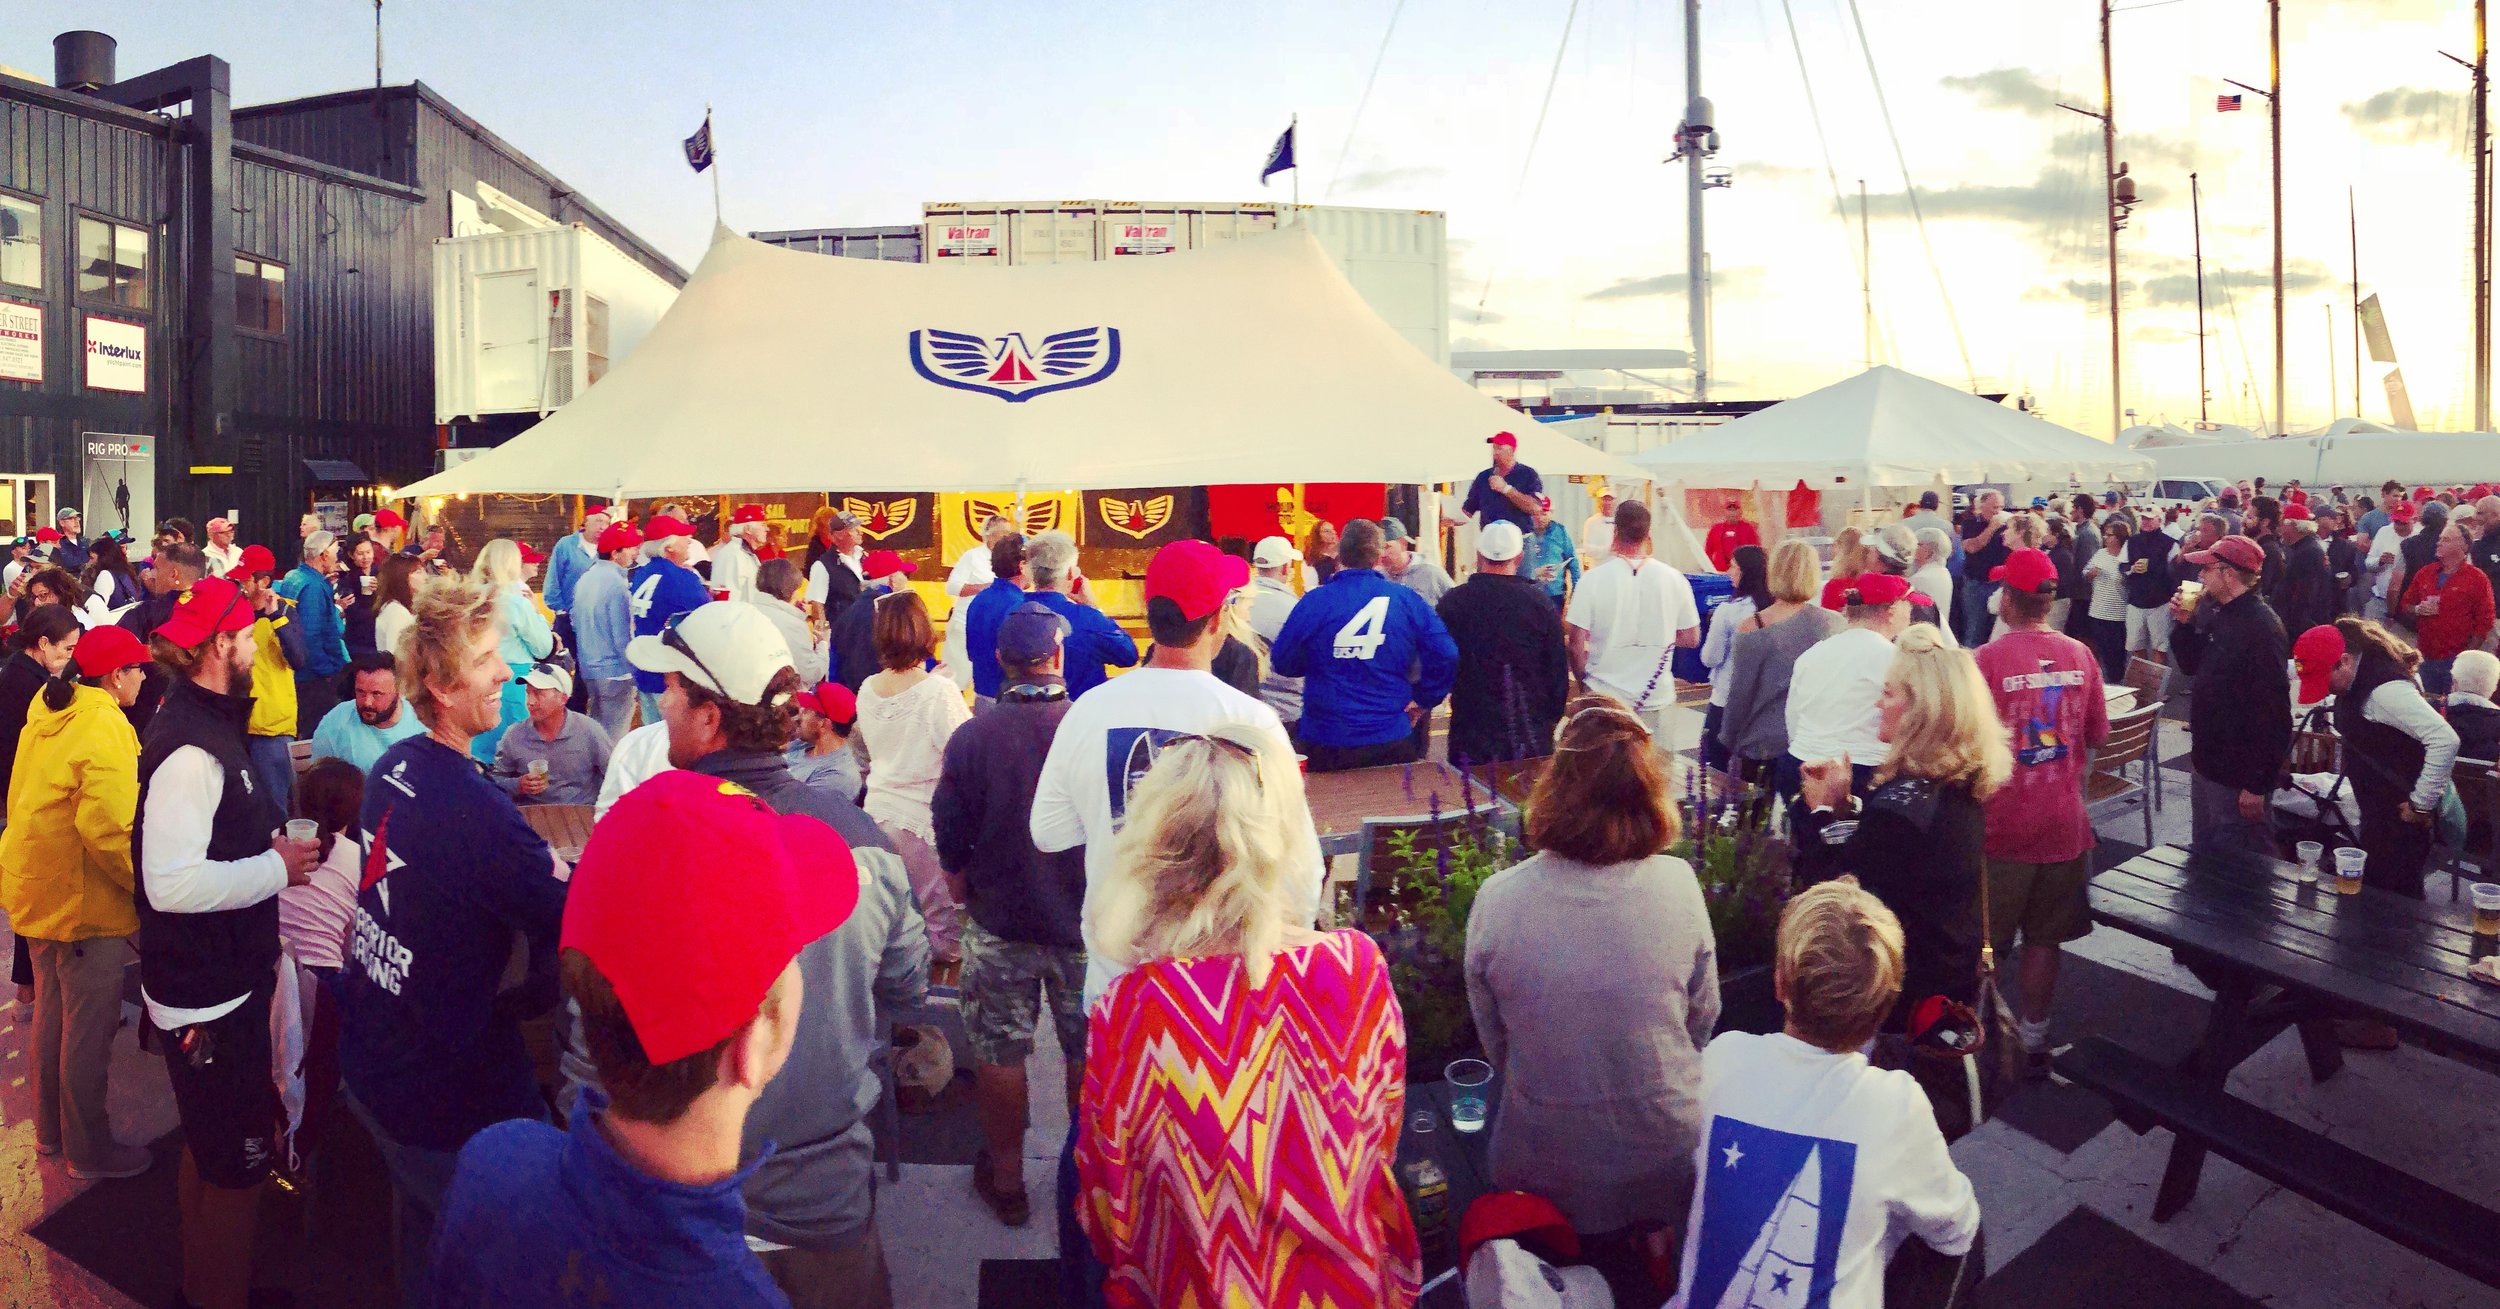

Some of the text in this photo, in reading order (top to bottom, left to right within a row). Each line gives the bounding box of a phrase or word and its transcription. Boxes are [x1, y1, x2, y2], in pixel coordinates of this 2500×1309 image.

[948, 227, 990, 239] Vatran
[1125, 225, 1168, 237] Varan
[10, 315, 38, 332] STREET
[99, 341, 141, 361] Interlux
[88, 442, 106, 455] RIG
[108, 443, 129, 456] PRO
[632, 573, 663, 618] 4
[1333, 596, 1390, 660] 4
[355, 906, 413, 978] ARRIOR
[351, 929, 402, 996] AING
